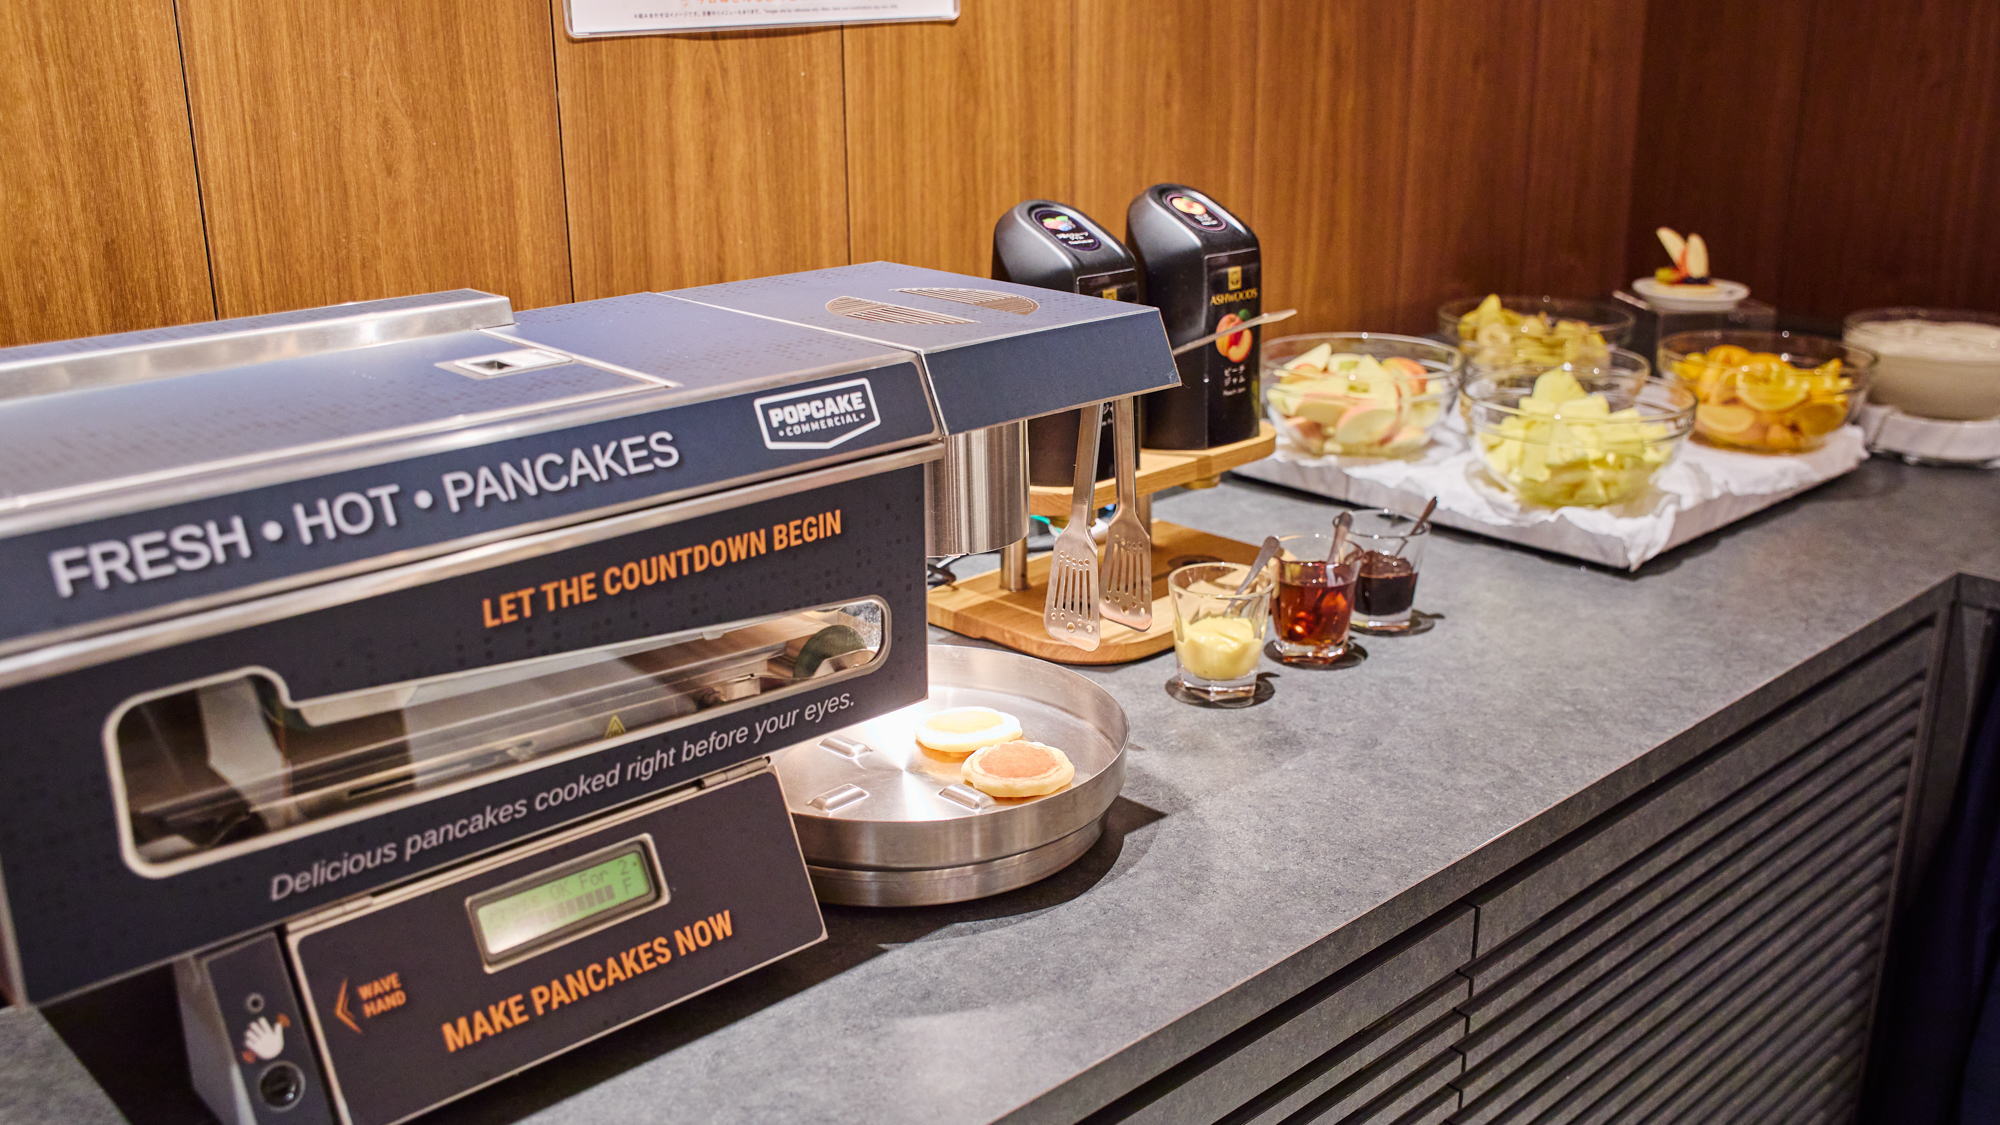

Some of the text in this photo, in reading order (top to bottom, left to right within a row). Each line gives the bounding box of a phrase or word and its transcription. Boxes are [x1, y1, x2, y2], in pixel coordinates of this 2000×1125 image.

[767, 391, 866, 428] POPCAKE
[785, 413, 860, 437] COMMERCIAL
[49, 430, 681, 598] FRESH HOT PANCAKES
[481, 508, 843, 629] LET THE COUNTDOWN BEGIN
[271, 692, 855, 901] Delicious pancakes cooked right before your eyes.
[356, 972, 402, 1001] WAVE
[362, 988, 407, 1018] HAND
[440, 908, 734, 1054] MAKE PANCAKES NOW
